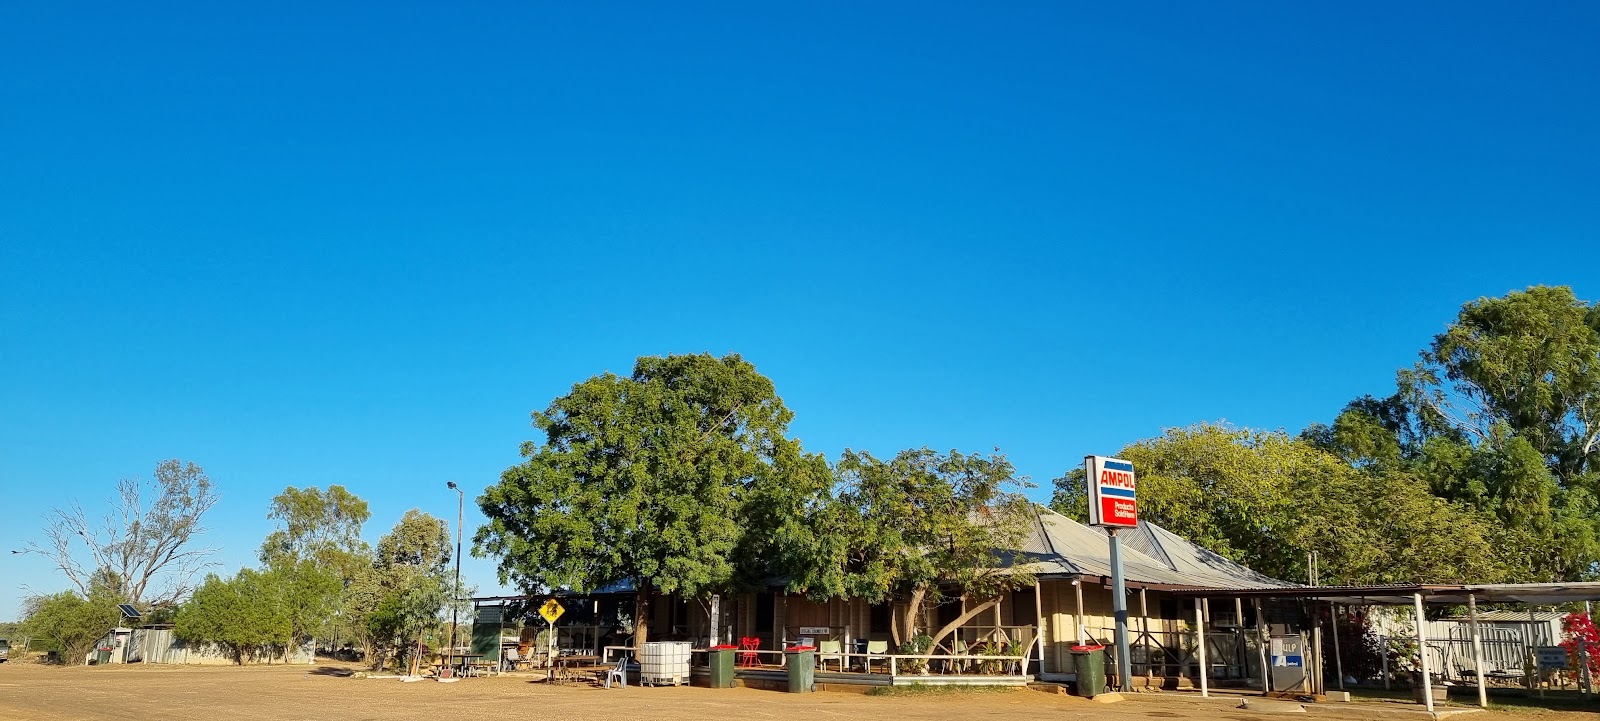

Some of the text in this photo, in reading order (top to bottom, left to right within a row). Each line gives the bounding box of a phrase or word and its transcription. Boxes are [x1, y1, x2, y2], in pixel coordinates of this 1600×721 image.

[1100, 470, 1134, 488] AMPOL
[1115, 501, 1134, 511] Products
[1114, 510, 1135, 519] Sold Here
[1283, 643, 1297, 652] ULP
